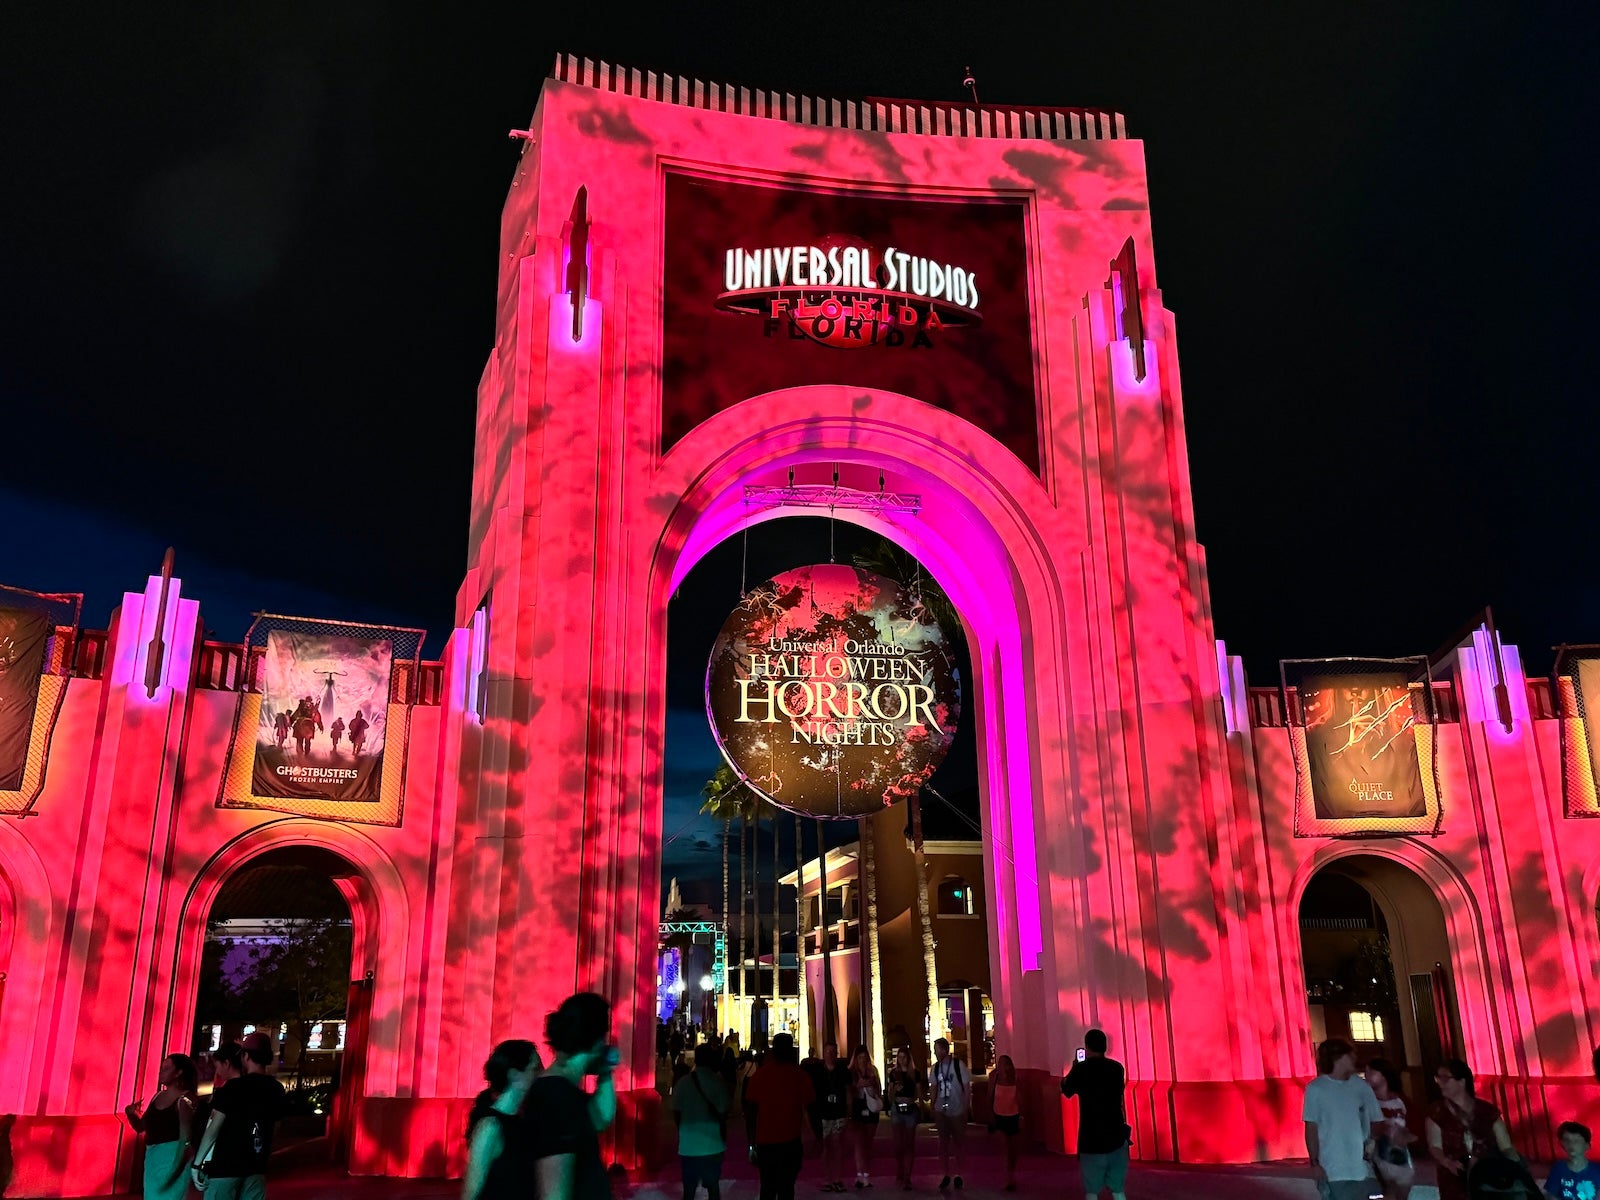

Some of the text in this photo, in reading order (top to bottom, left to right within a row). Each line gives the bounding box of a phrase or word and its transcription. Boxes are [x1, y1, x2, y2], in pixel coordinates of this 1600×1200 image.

[725, 246, 979, 309] UNIVERSAL STUDIOS
[771, 298, 944, 331] FLORIDA
[769, 636, 905, 656] Universal Orlando
[748, 654, 926, 681] HALLOWEEN
[734, 679, 945, 736] HORROR
[790, 721, 896, 746] NIGHTS
[276, 765, 358, 779] GHOSTBUSTERS
[1348, 782, 1384, 795] QUIET
[1358, 790, 1394, 801] PLACE
